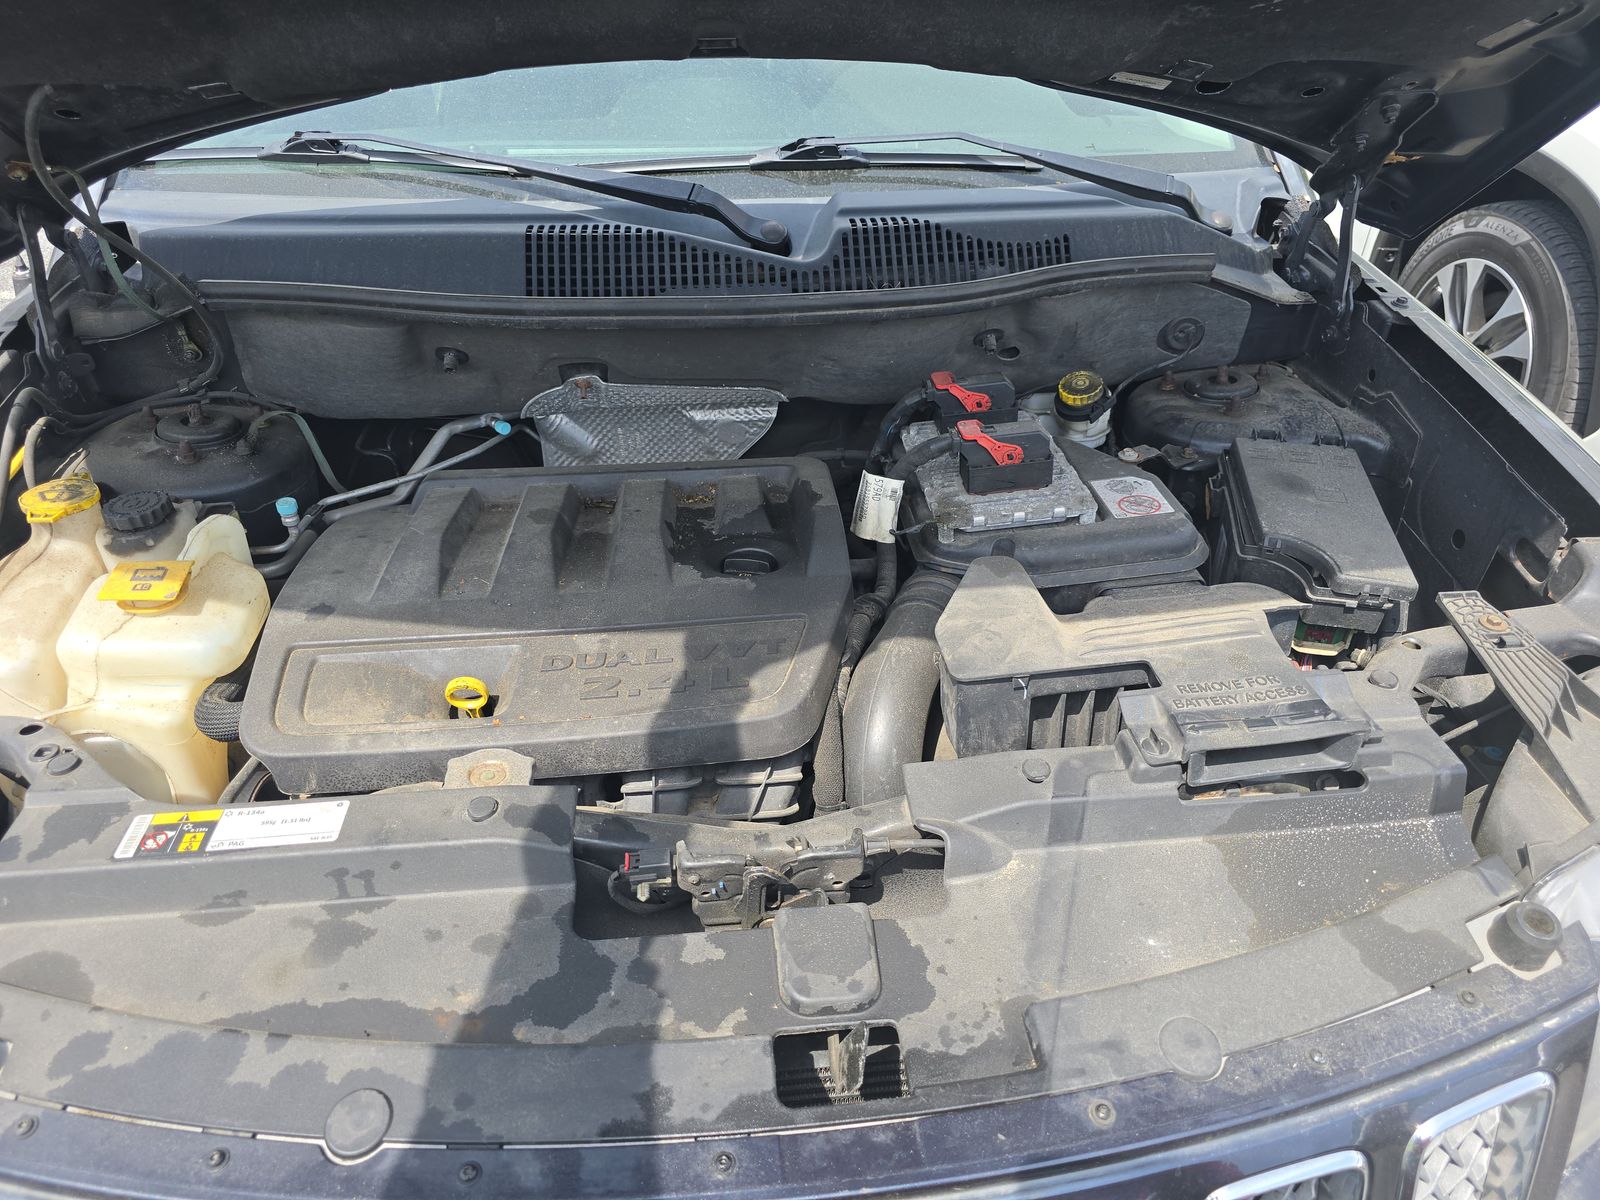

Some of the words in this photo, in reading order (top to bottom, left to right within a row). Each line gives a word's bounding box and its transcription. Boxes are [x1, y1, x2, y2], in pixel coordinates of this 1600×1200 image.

[1484, 221, 1520, 241] ALENZA
[871, 478, 884, 502] 579AD
[540, 647, 674, 672] DUAL
[692, 637, 787, 661] VVT
[579, 667, 750, 701] 2.4L
[1176, 679, 1244, 694] REMOVE
[1245, 675, 1281, 689] FOR
[1173, 693, 1240, 709] BATTERY
[1246, 686, 1308, 703] ACCESS
[237, 809, 265, 817] R-134a
